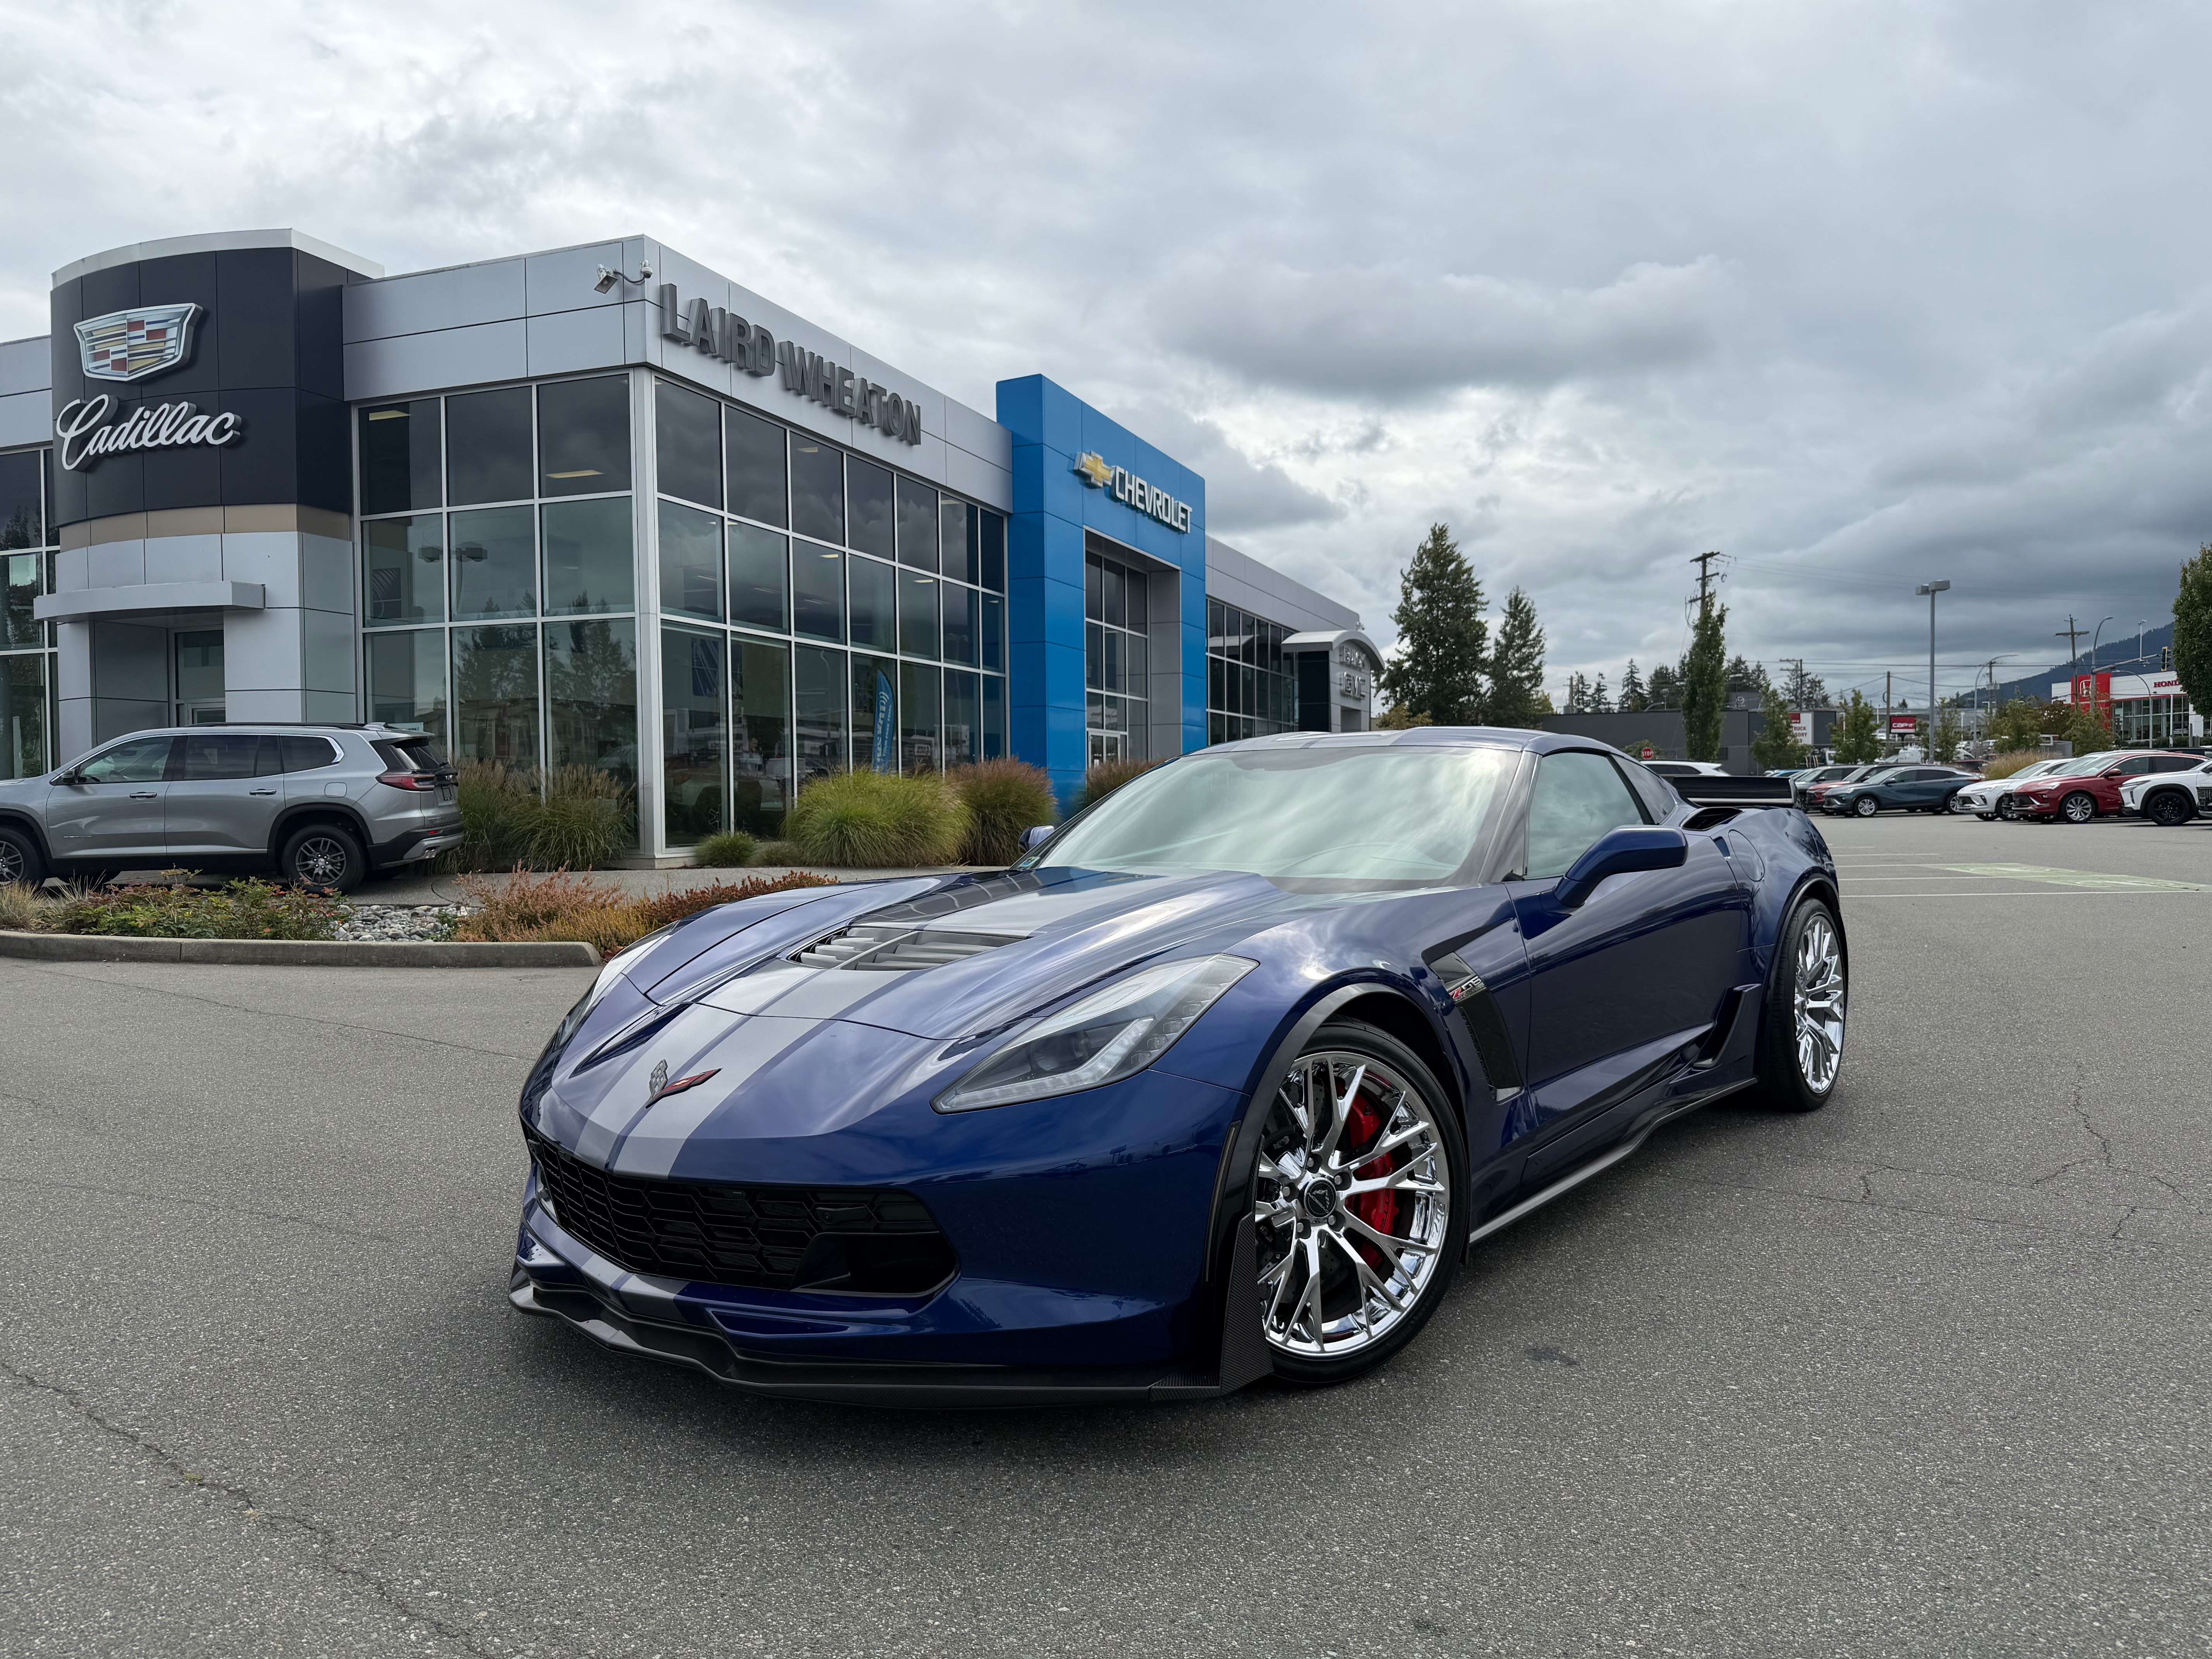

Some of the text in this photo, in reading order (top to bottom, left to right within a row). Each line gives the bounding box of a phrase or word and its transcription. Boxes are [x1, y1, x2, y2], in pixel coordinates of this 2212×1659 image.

[661, 283, 921, 445] LAIRD WHEATON
[57, 394, 237, 471] Cadillac
[1115, 465, 1192, 534] CHEVROLET
[1341, 646, 1366, 669] BUICK
[1341, 671, 1365, 700] GMC
[2153, 680, 2181, 688] HOND
[1449, 975, 1482, 1000] Z06
